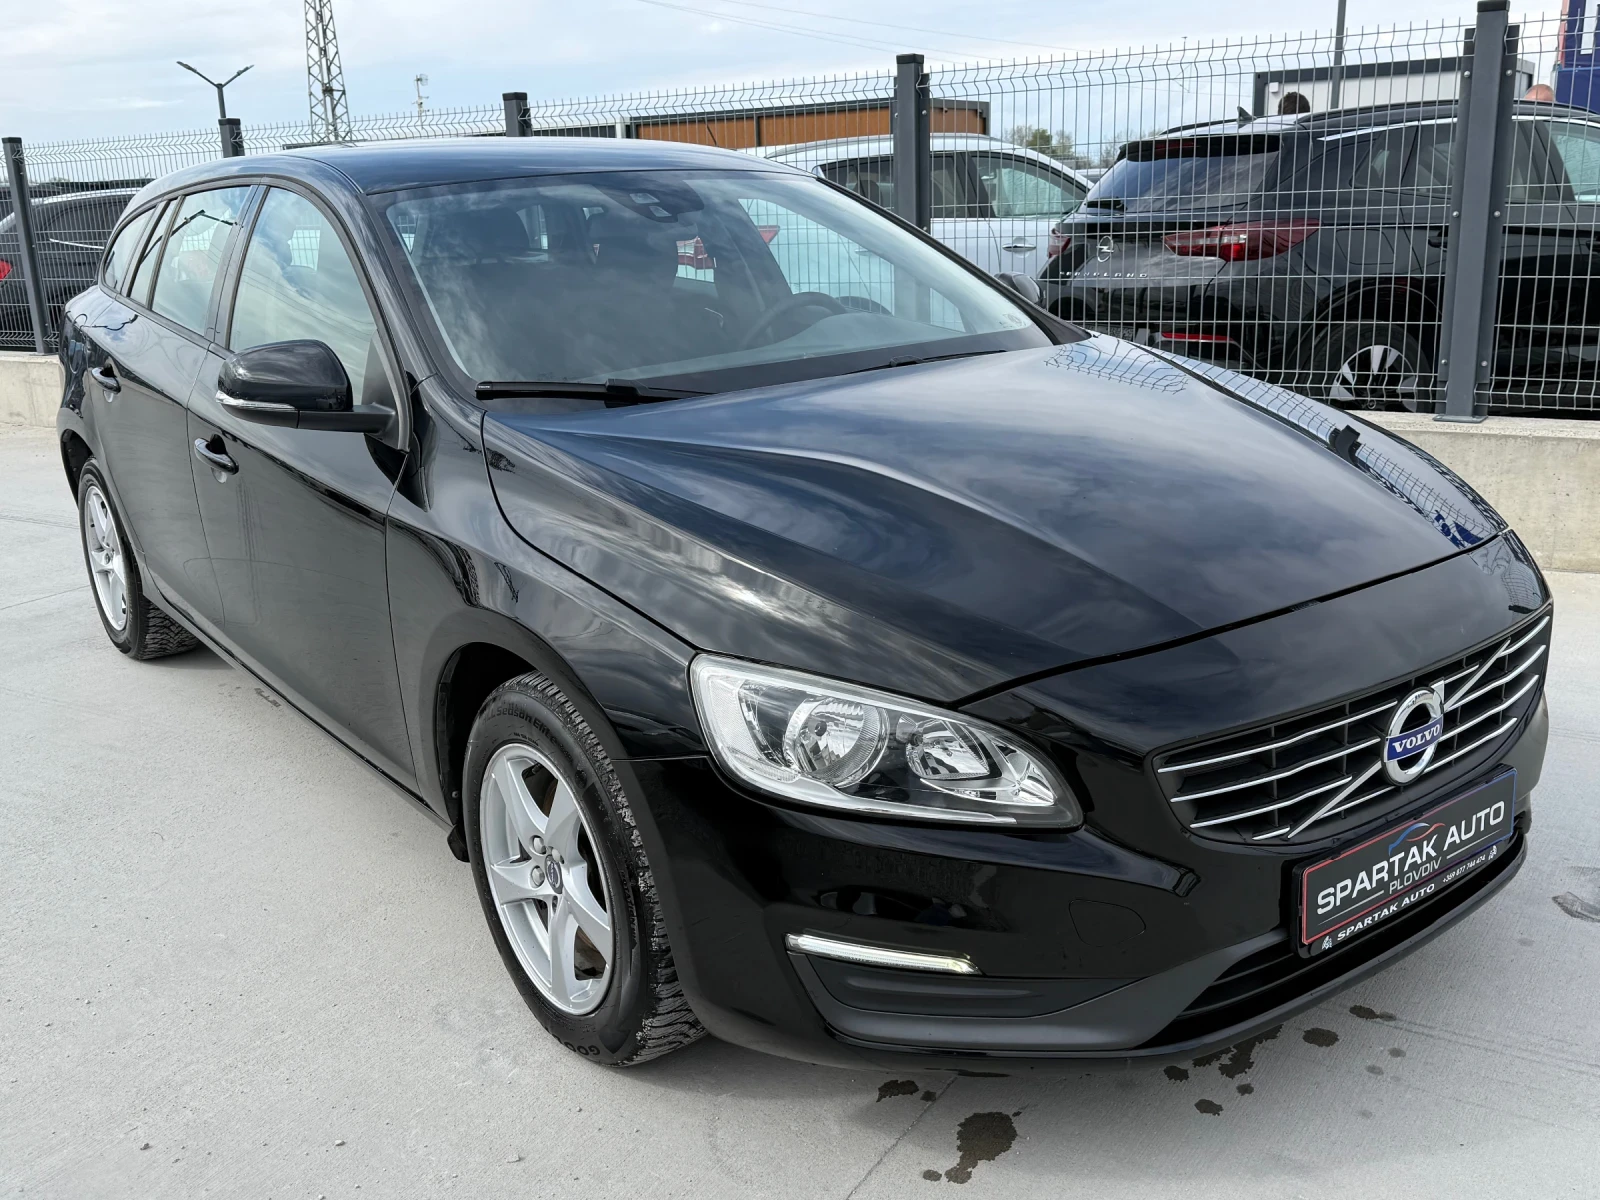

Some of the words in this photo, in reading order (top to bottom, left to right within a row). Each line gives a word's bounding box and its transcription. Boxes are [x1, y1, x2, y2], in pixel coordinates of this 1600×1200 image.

[1392, 724, 1440, 753] VOLVO
[1316, 833, 1438, 915] SPARTAK
[1443, 800, 1506, 851] AUTO
[1389, 856, 1443, 895] PLOVDIV
[1337, 904, 1399, 941] SPARTAK
[1401, 883, 1436, 908] AUTO
